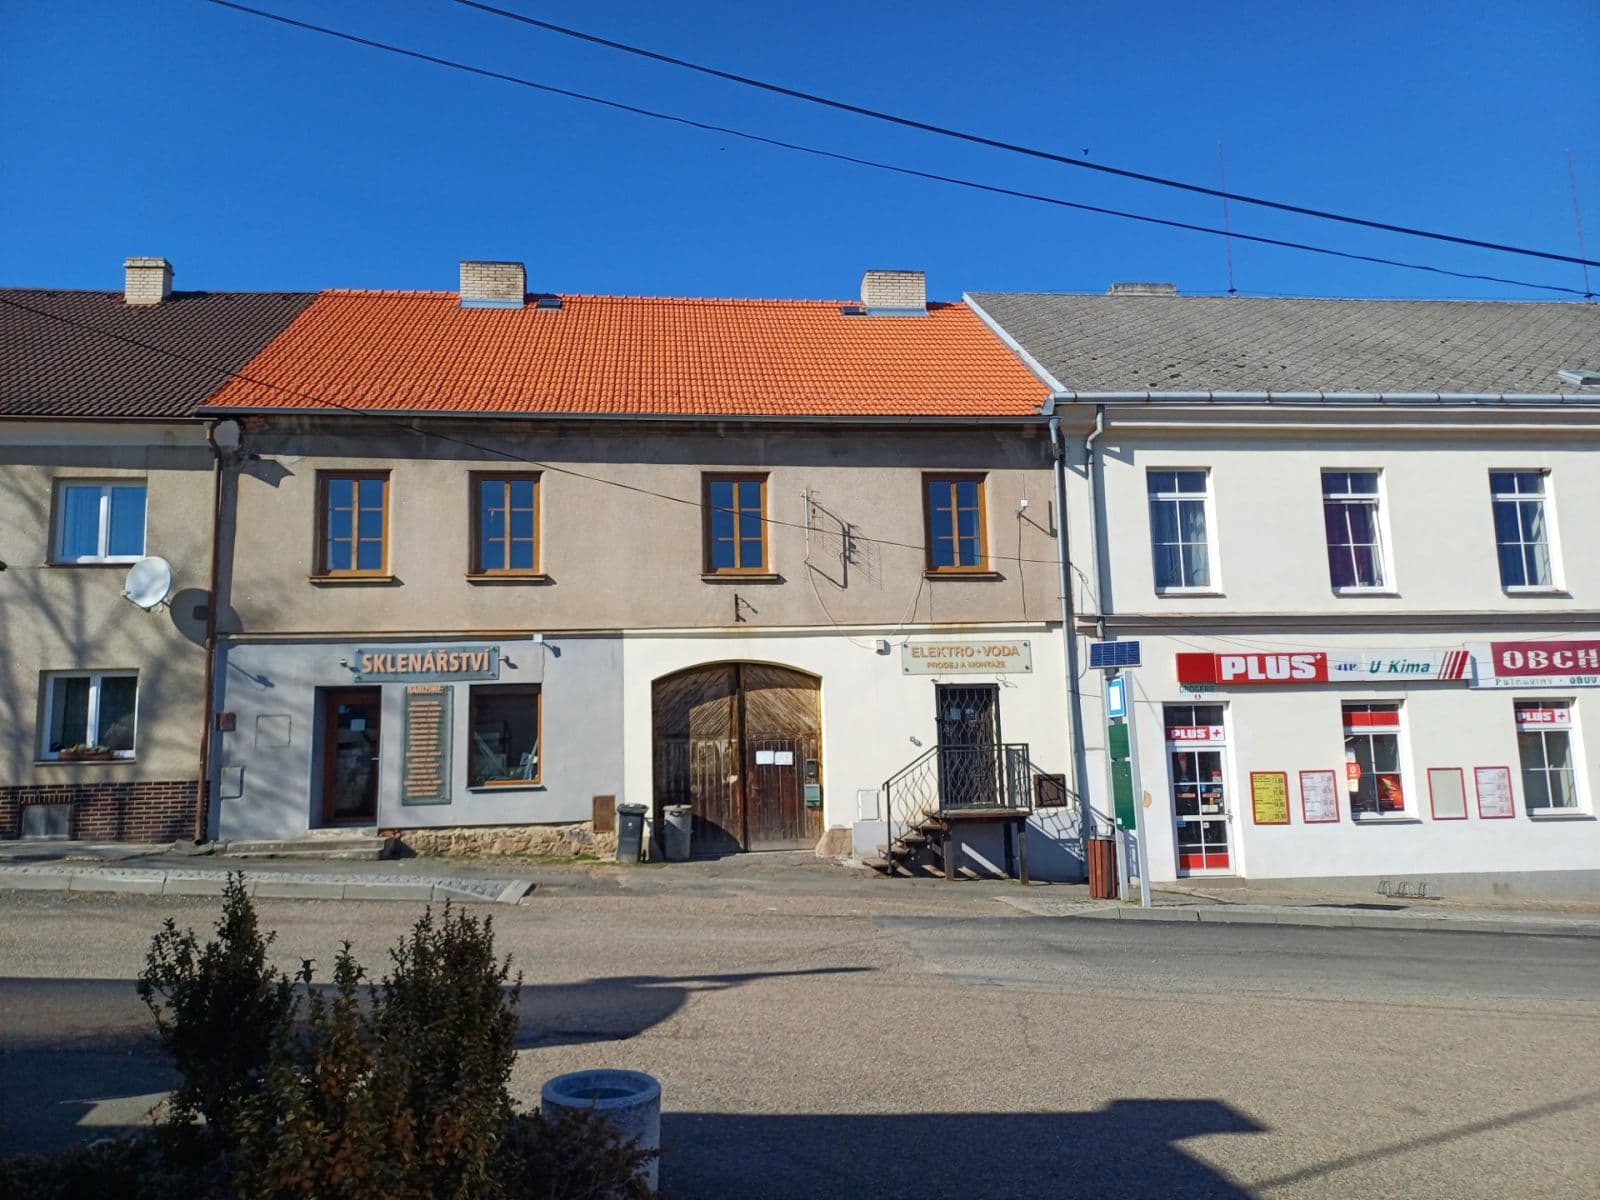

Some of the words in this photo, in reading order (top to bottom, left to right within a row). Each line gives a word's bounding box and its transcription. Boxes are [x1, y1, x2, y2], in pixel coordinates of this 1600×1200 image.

[911, 646, 974, 658] ELEKTRO
[982, 646, 1020, 657] VODA
[1502, 649, 1599, 669] OBCH
[362, 649, 489, 673] SKLENÁŘSTVÍ
[1221, 655, 1317, 680] PLUS
[1369, 660, 1381, 673] U
[1388, 659, 1430, 673] Kima
[1172, 729, 1206, 739] PLUS
